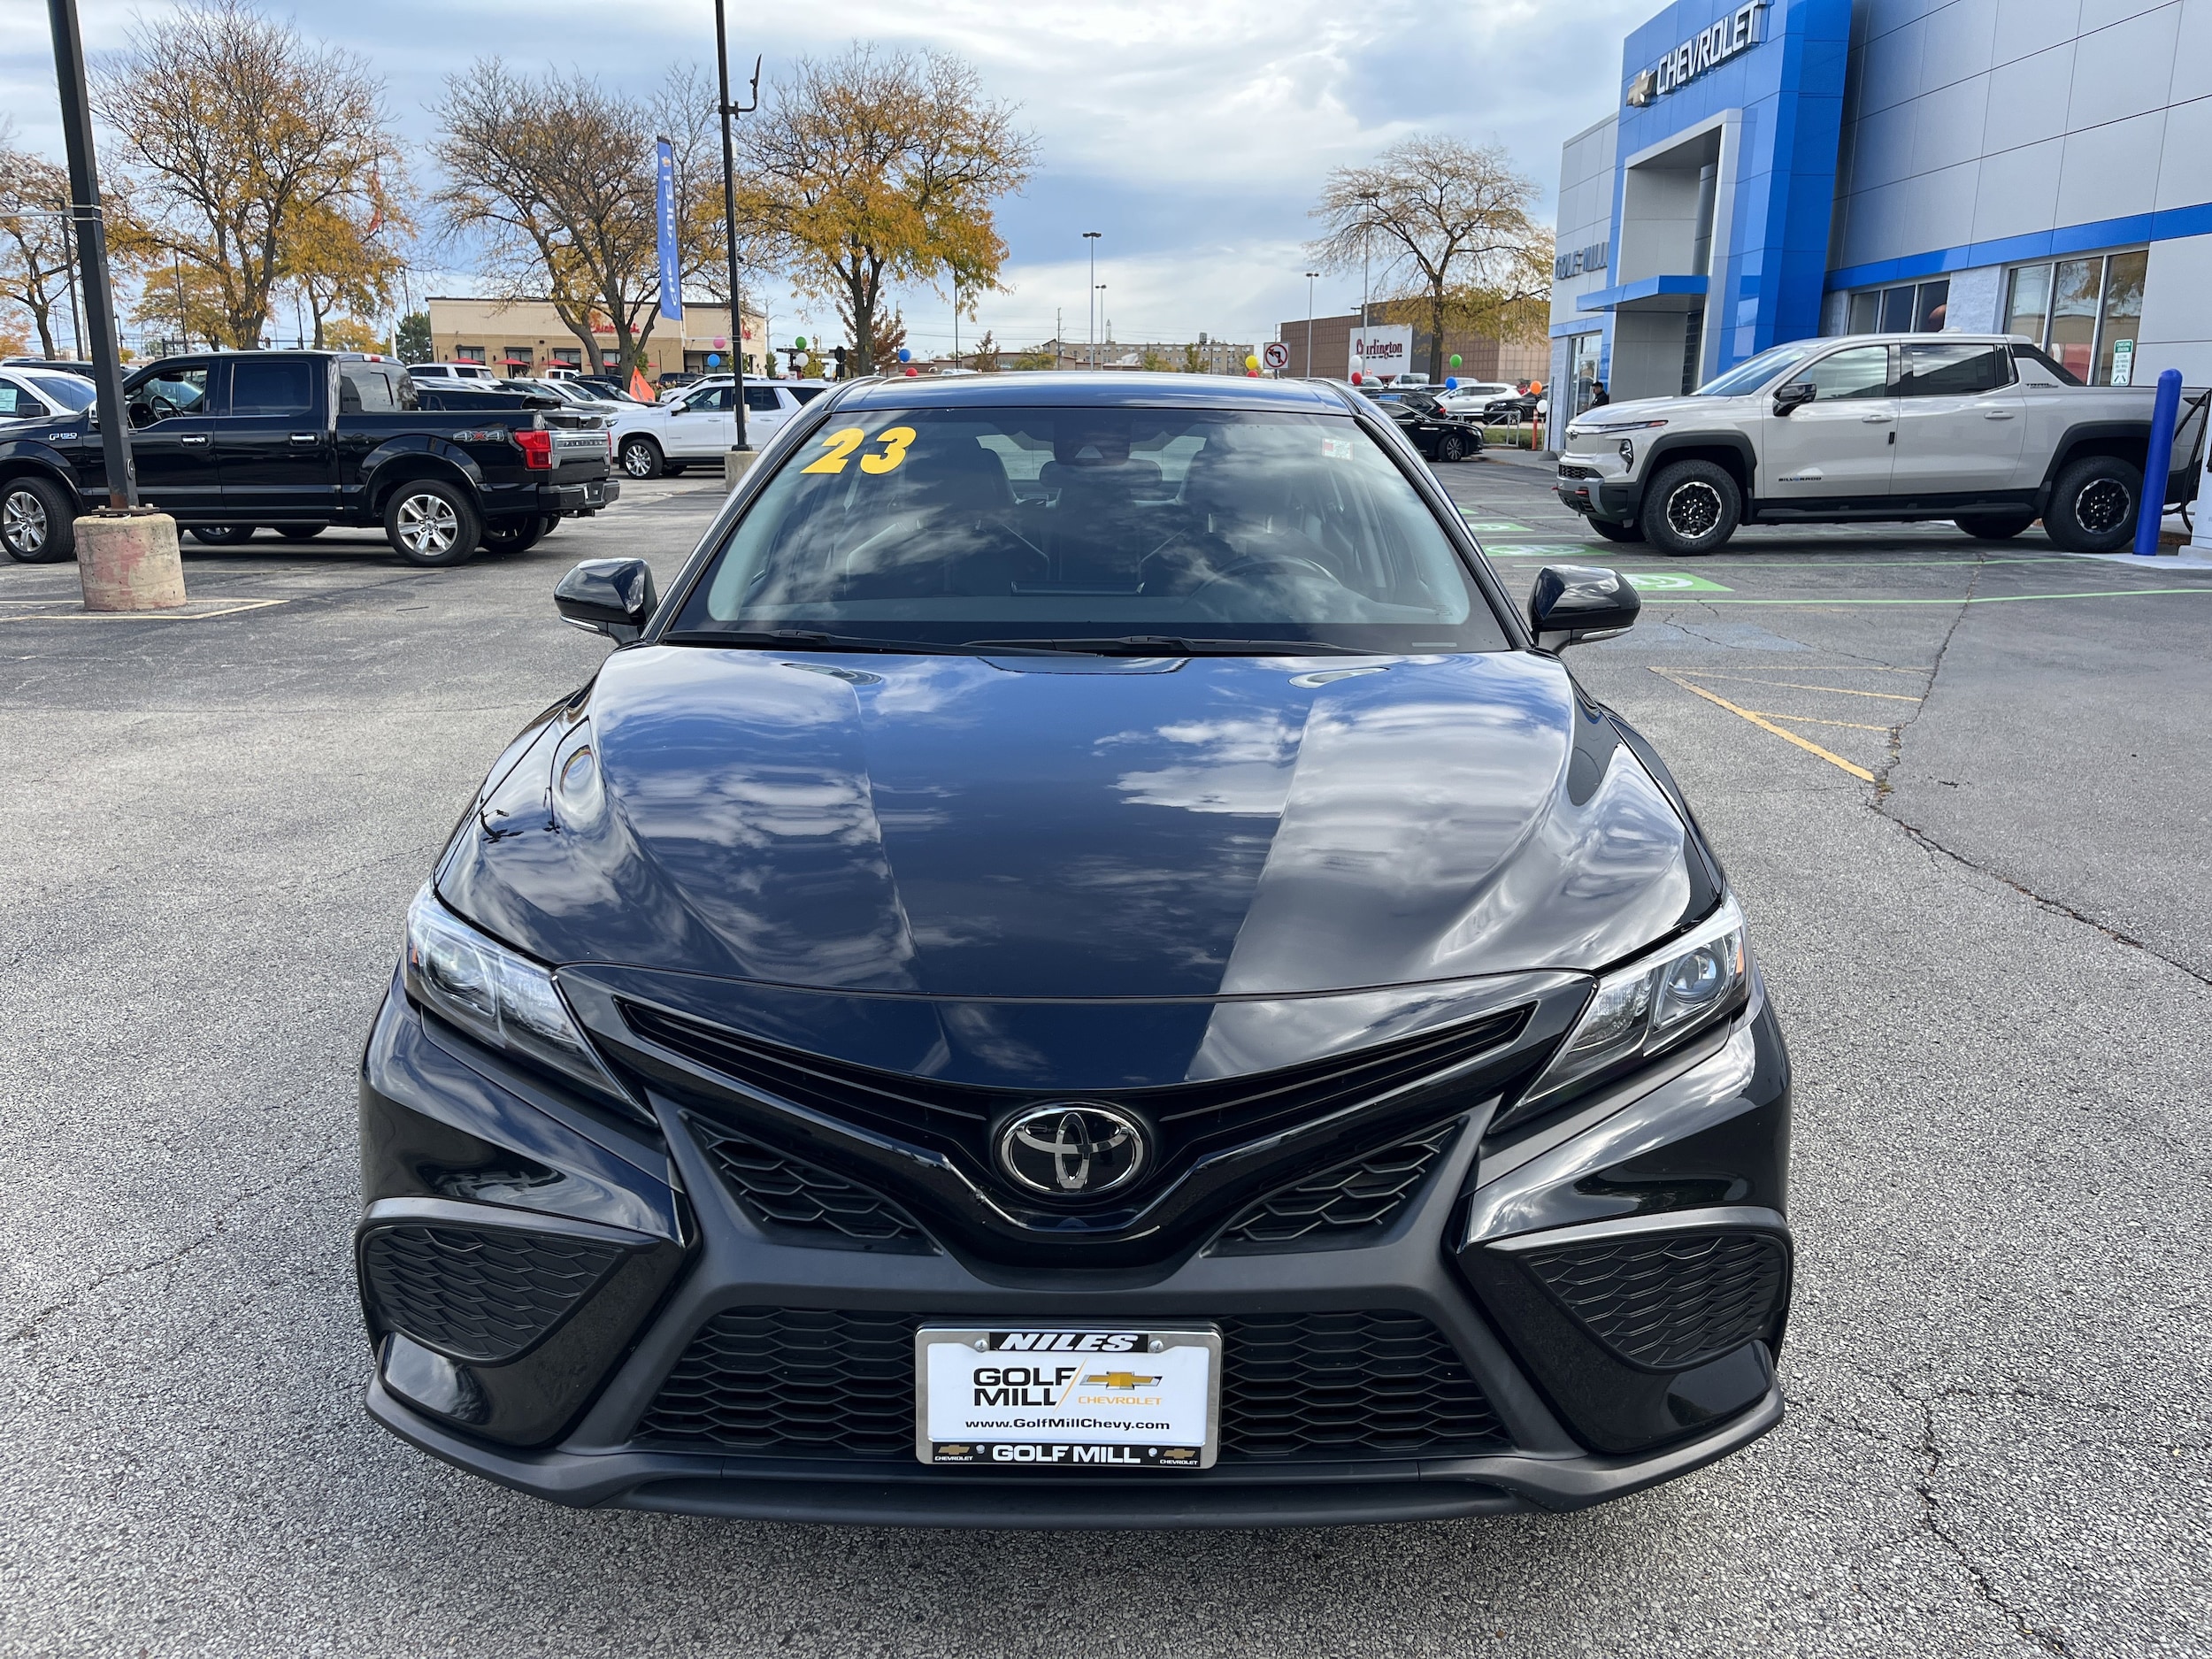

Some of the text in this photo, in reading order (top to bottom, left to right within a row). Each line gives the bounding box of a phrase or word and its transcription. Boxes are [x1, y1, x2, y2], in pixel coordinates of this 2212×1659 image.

[1656, 0, 1762, 96] CHEVROLET
[1555, 242, 1609, 280] GOLF MILL
[1356, 338, 1402, 359] Burlington
[799, 427, 917, 474] 23
[998, 1333, 1139, 1352] NILES
[973, 1367, 1077, 1386] GOLF
[974, 1387, 1057, 1406] MILL
[1078, 1396, 1162, 1405] CHEVROLET
[965, 1418, 1170, 1431] www.GolfMillChevy.com
[992, 1444, 1141, 1463] GOLF MILL
